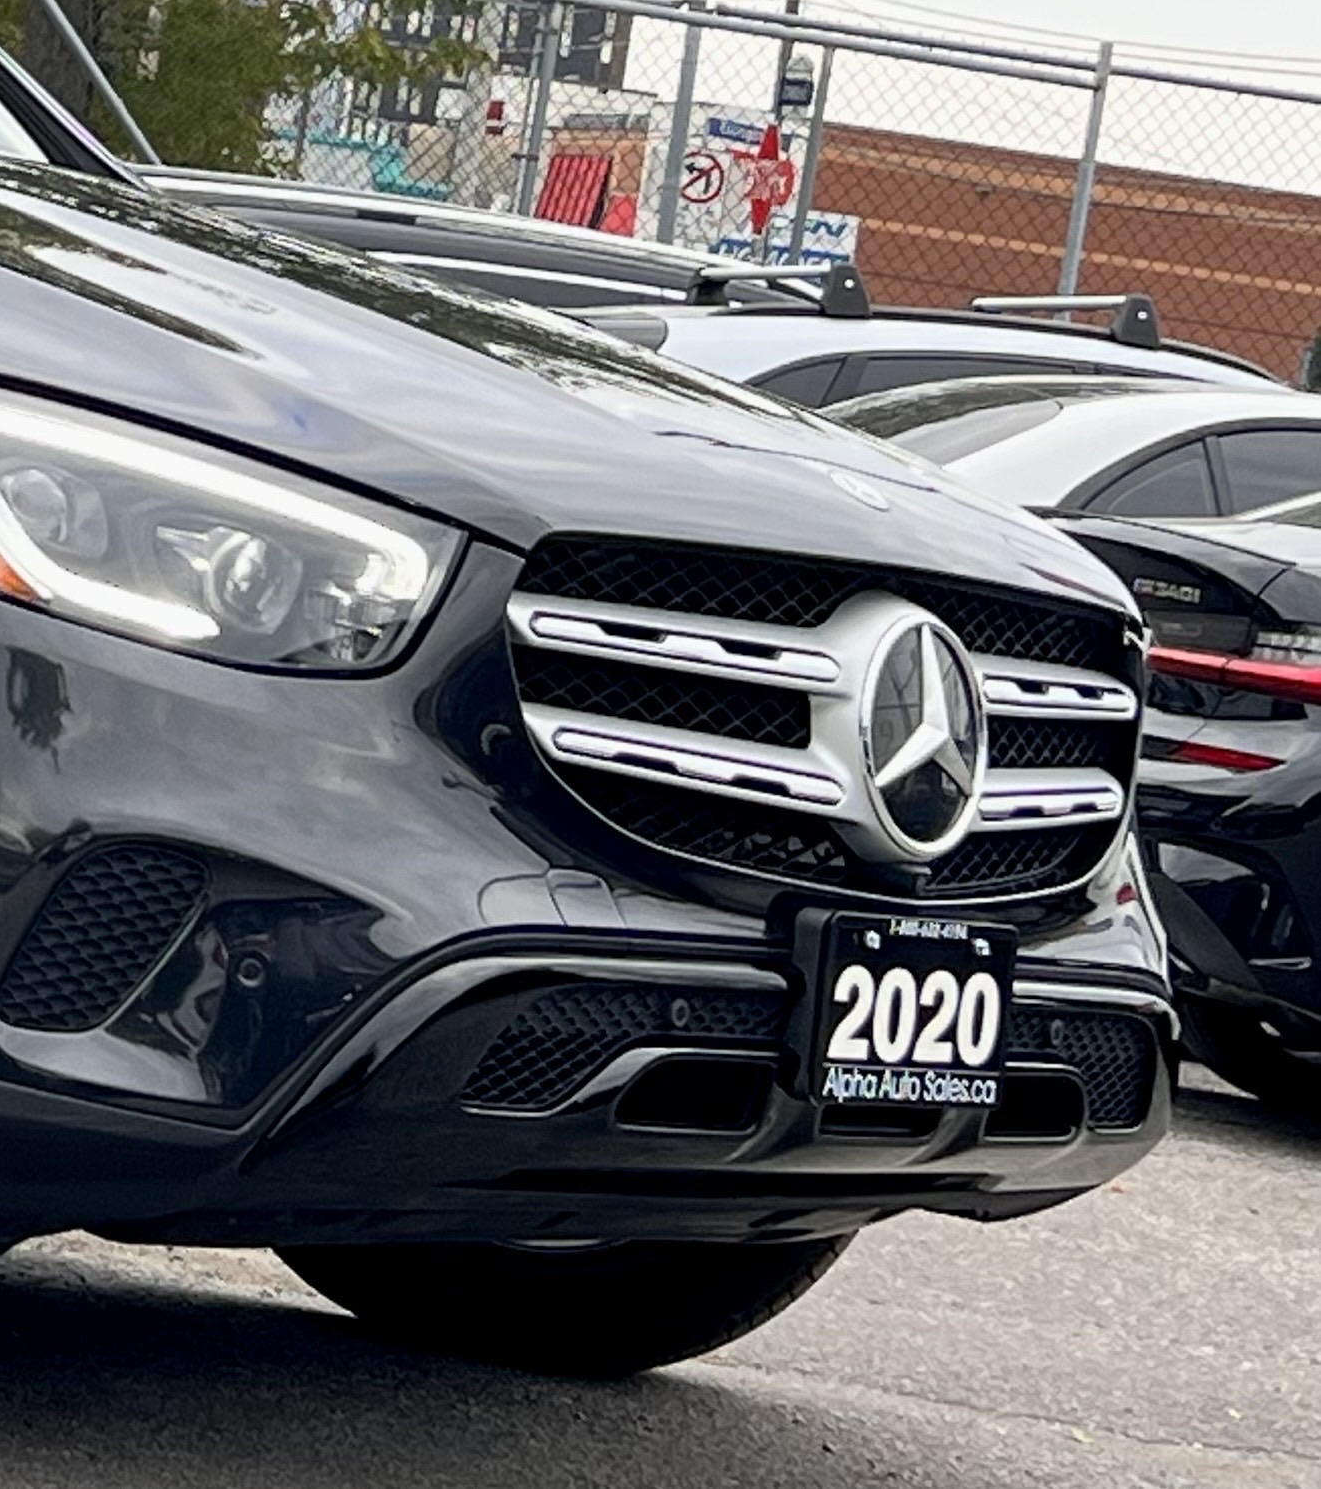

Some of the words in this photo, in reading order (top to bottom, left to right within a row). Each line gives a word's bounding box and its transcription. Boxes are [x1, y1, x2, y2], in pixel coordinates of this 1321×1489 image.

[826, 964, 1001, 1067] 2020
[822, 1066, 877, 1103] Alpha
[879, 1068, 921, 1101] Auto
